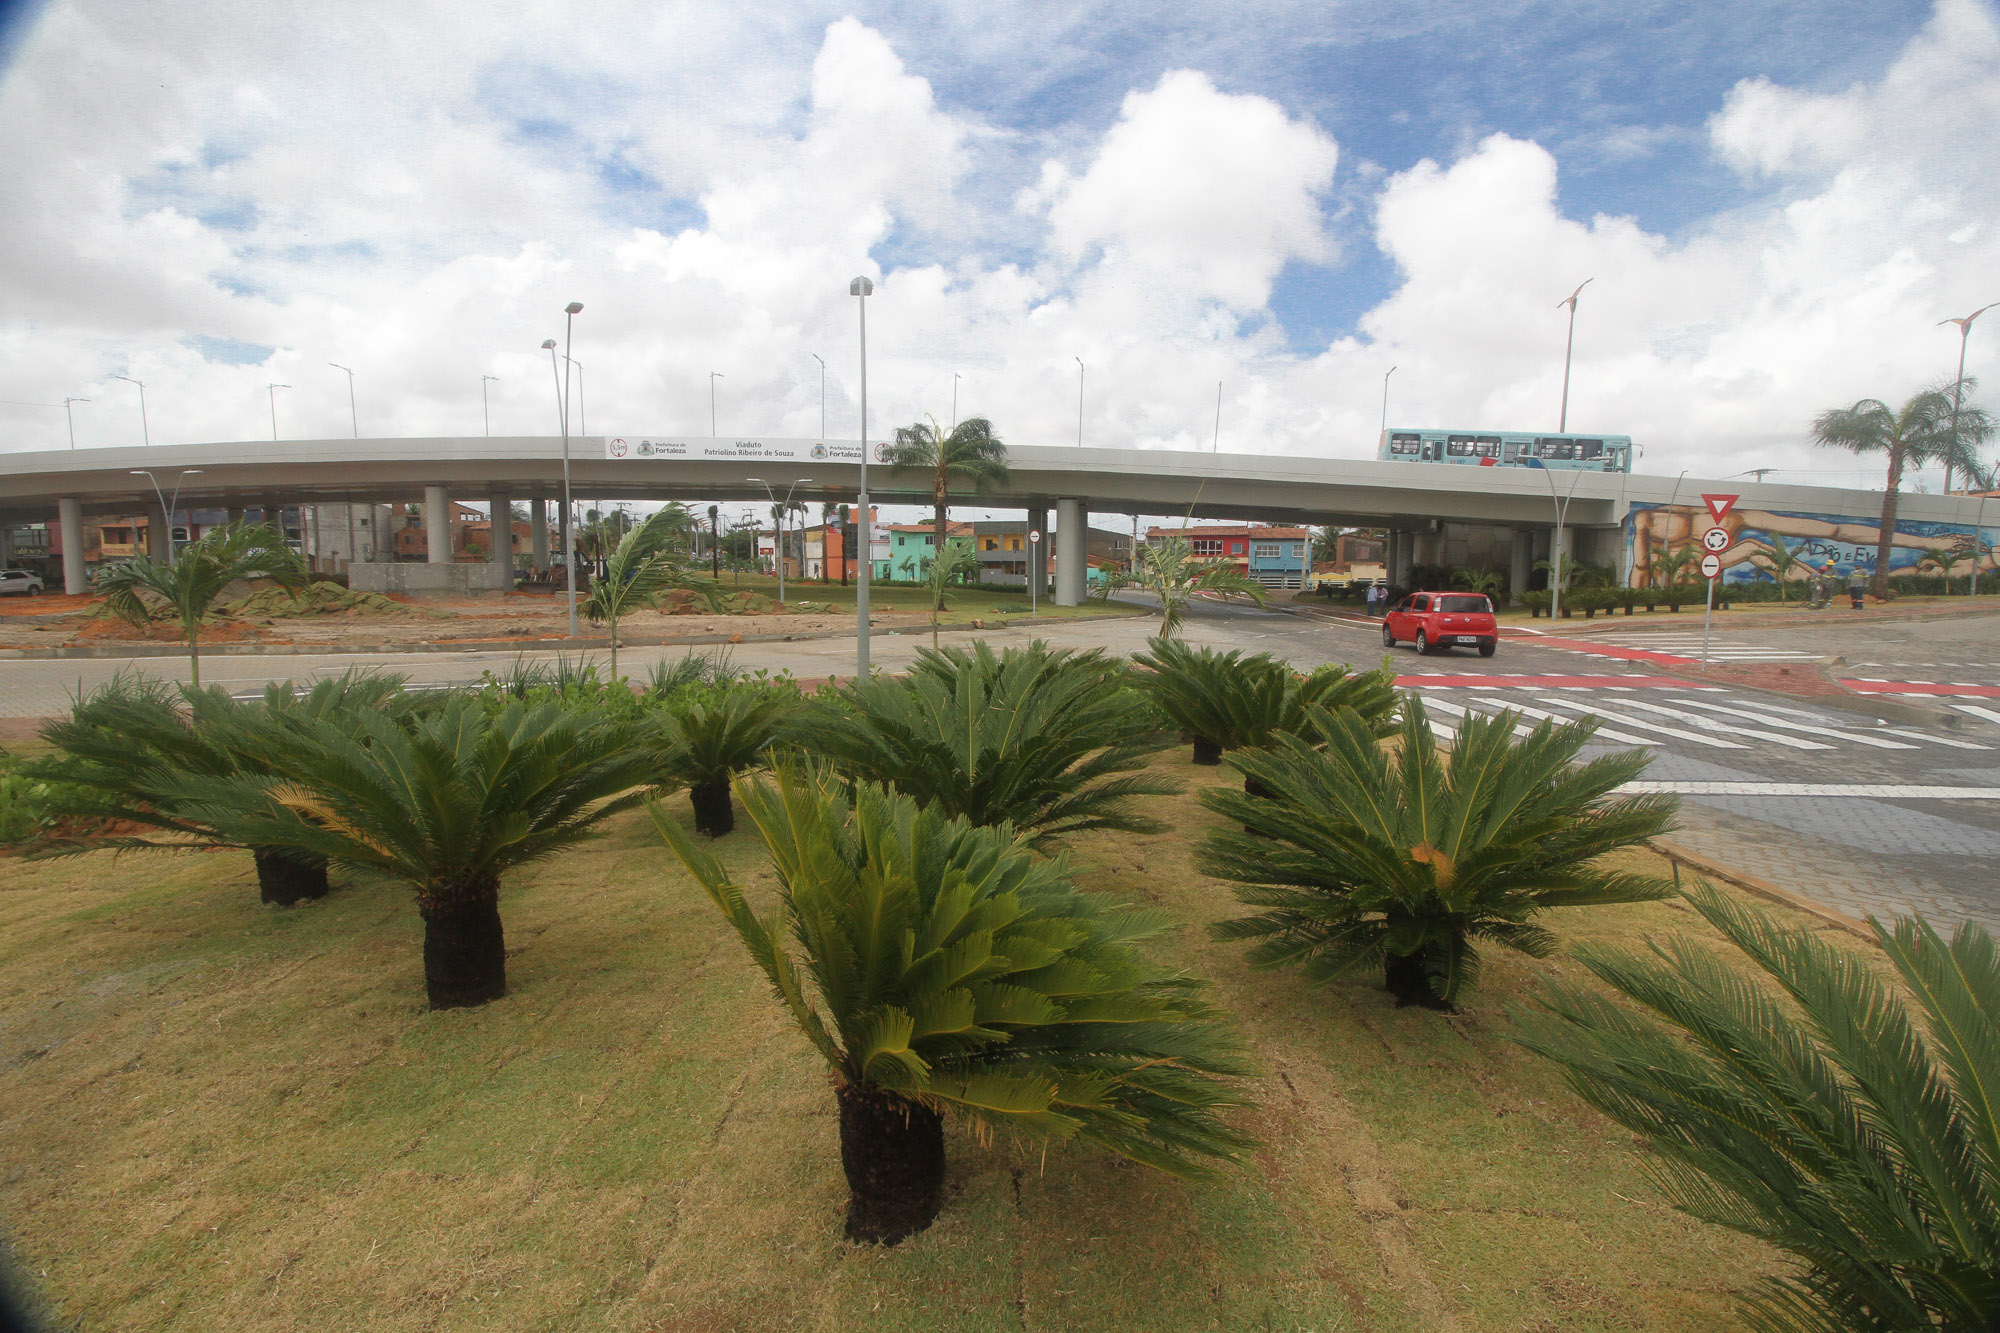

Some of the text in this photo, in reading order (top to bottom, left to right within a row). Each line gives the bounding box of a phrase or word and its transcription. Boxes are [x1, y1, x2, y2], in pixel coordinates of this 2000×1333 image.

[704, 448, 737, 456] Patriolino
[1801, 538, 1878, 562] ADÃO E EV
